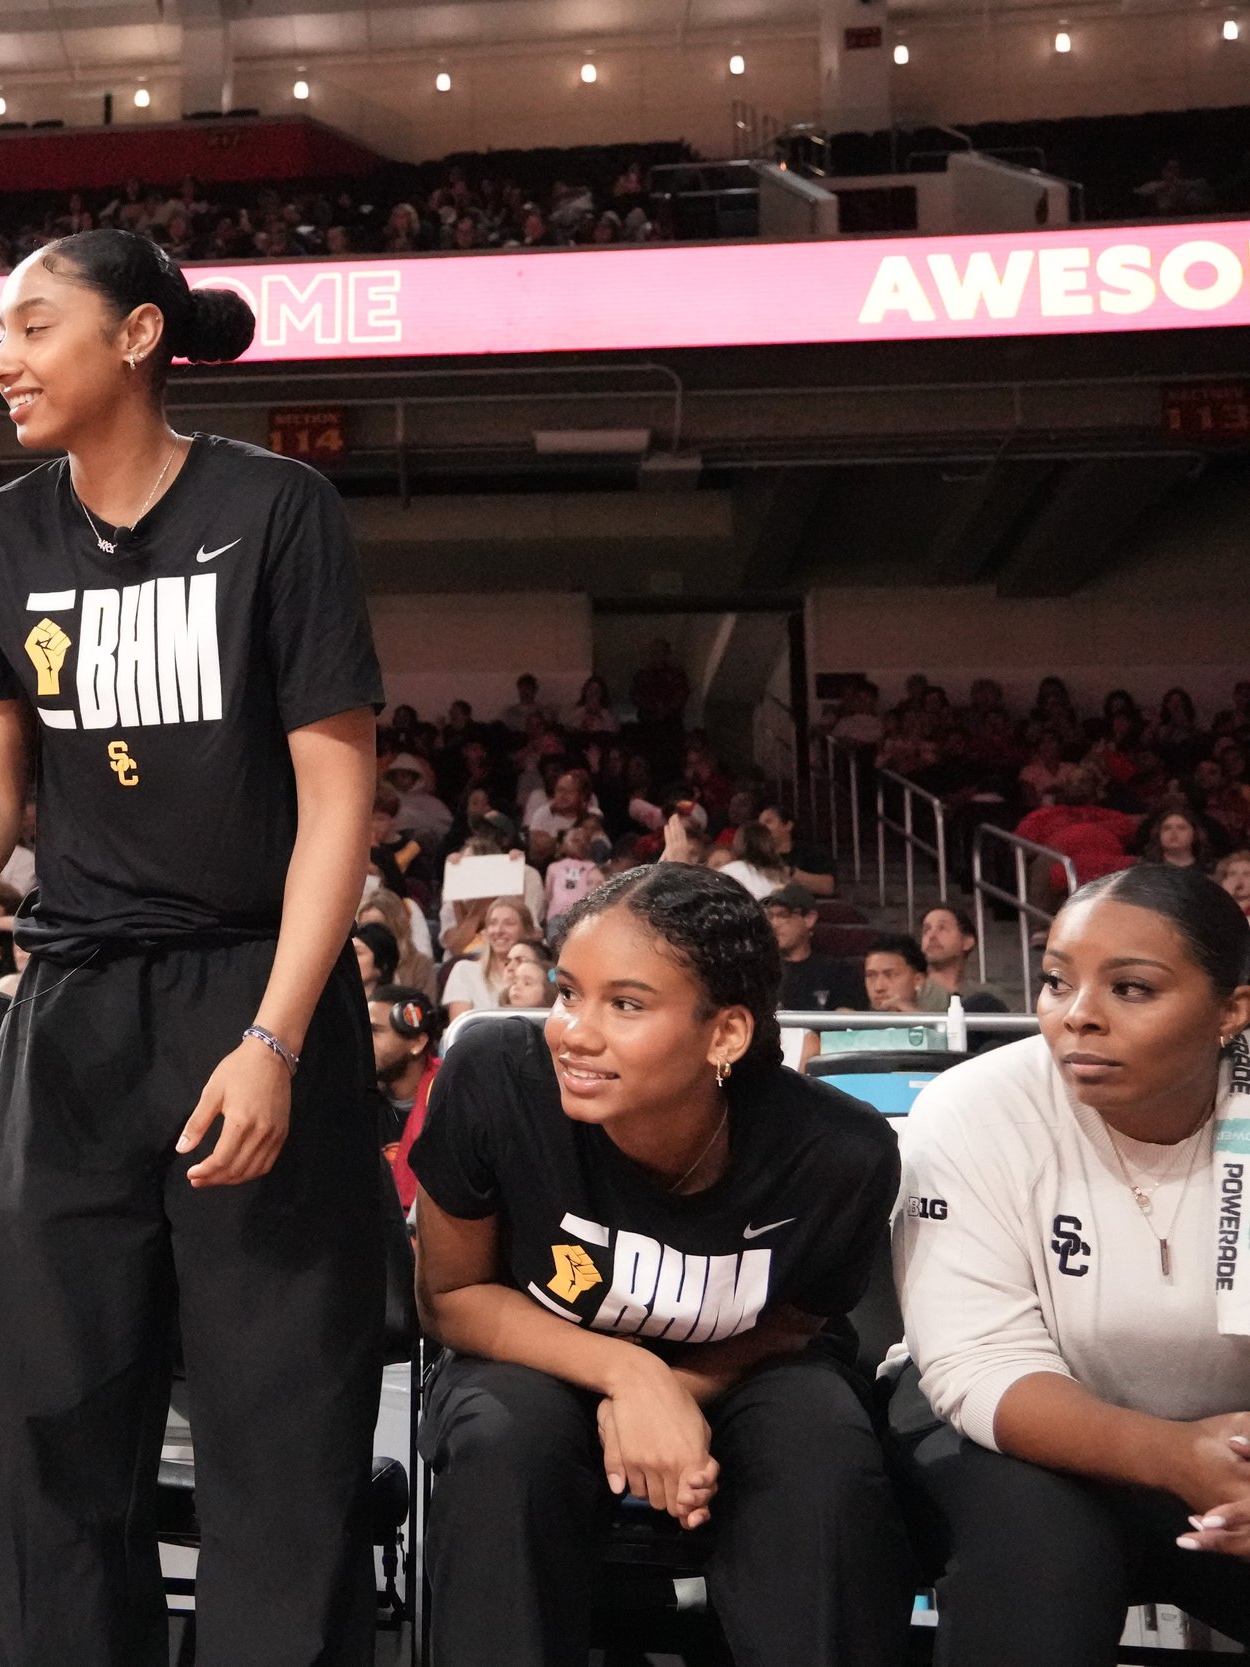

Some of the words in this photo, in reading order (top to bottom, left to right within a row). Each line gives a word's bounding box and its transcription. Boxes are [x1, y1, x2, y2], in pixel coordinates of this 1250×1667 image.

[857, 240, 1250, 324] AWESO
[270, 430, 344, 452] 114
[76, 573, 223, 730] BHM
[107, 740, 139, 787] SC
[1051, 1214, 1092, 1278] SC
[1215, 1162, 1245, 1292] POWERADE
[589, 1229, 772, 1343] BHM
